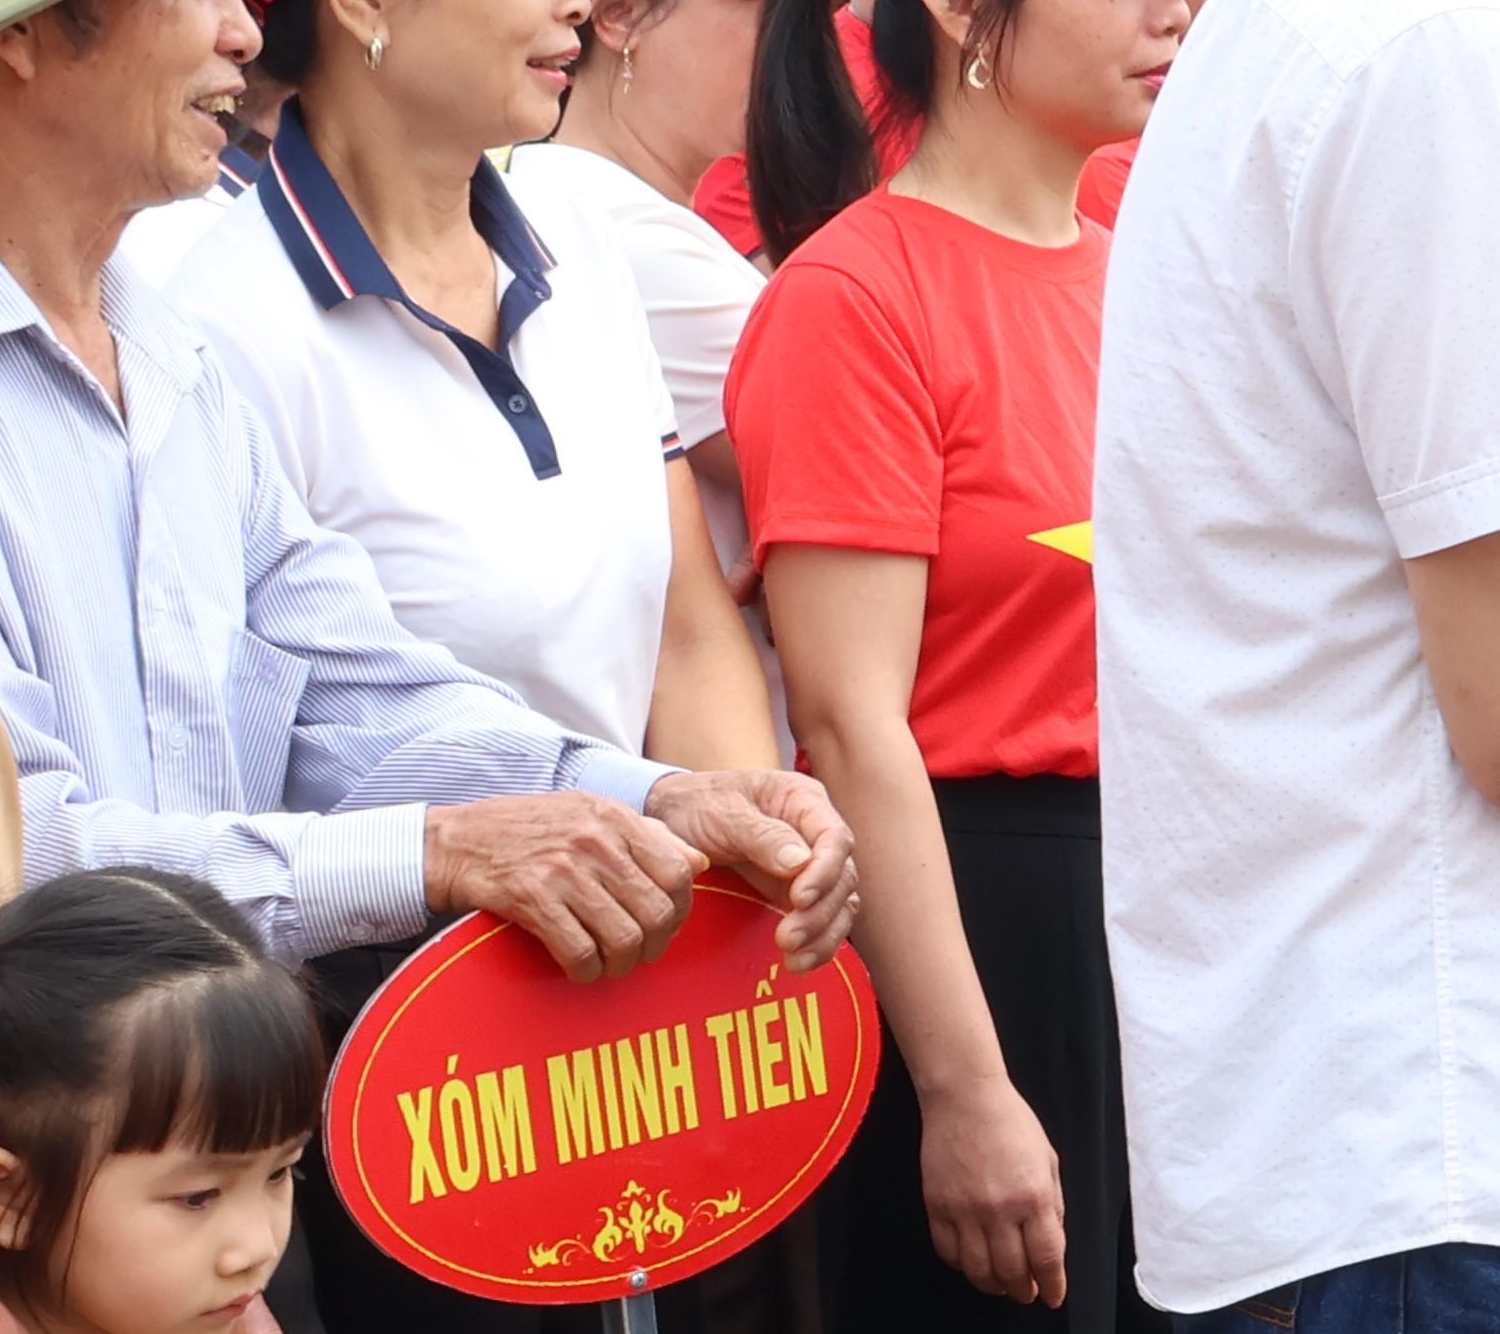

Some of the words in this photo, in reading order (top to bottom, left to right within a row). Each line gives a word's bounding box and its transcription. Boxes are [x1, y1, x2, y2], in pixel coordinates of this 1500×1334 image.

[397, 1055, 537, 1205] XÓM
[546, 1023, 699, 1165] MINH
[706, 963, 828, 1122] TIẾN
